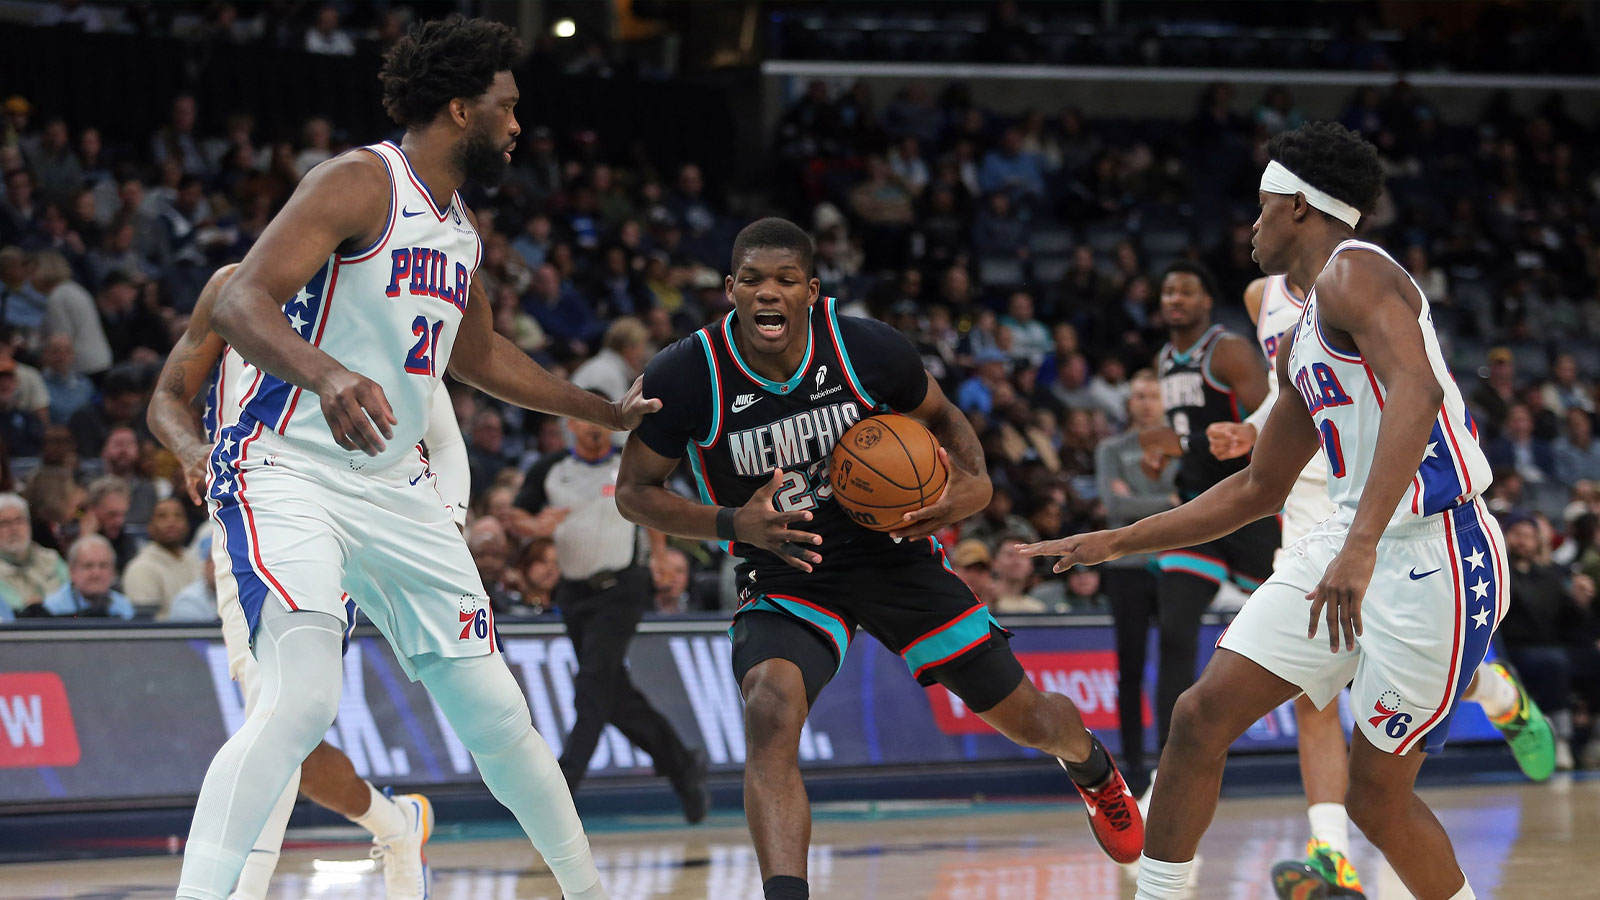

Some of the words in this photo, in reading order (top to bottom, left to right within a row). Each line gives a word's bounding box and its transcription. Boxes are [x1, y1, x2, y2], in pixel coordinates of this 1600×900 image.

[385, 247, 469, 317] PHILA
[404, 315, 444, 378] 21
[735, 393, 755, 406] NIKE
[809, 384, 843, 401] Robinhood
[458, 608, 488, 641] 76
[1368, 698, 1413, 740] 76
